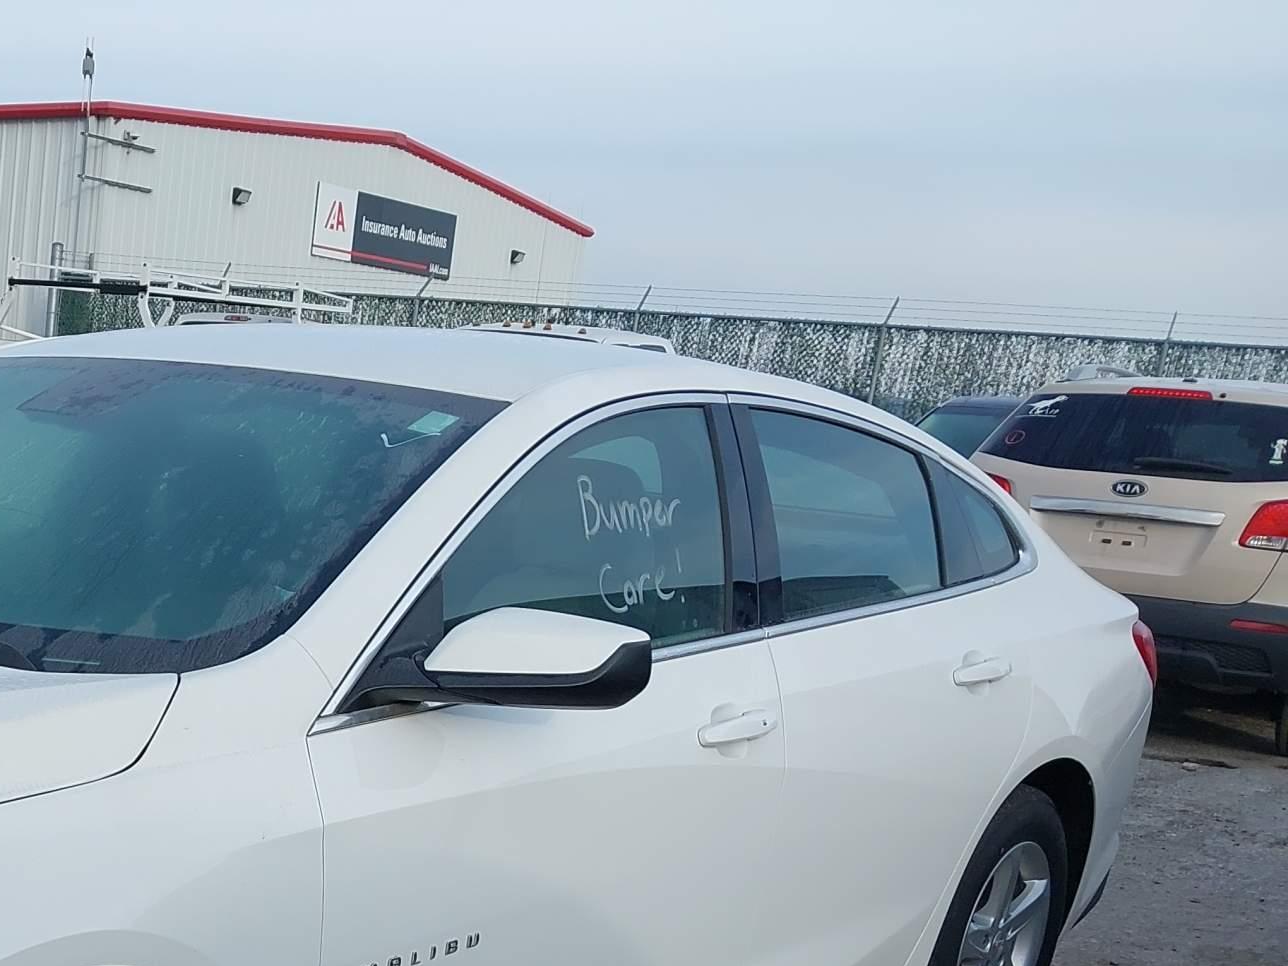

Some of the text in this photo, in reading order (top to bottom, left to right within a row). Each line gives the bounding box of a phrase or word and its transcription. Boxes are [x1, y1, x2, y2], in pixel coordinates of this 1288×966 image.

[361, 215, 448, 249] Insurance Auto Auctions
[1115, 483, 1141, 494] KIA
[577, 475, 681, 541] Bumper
